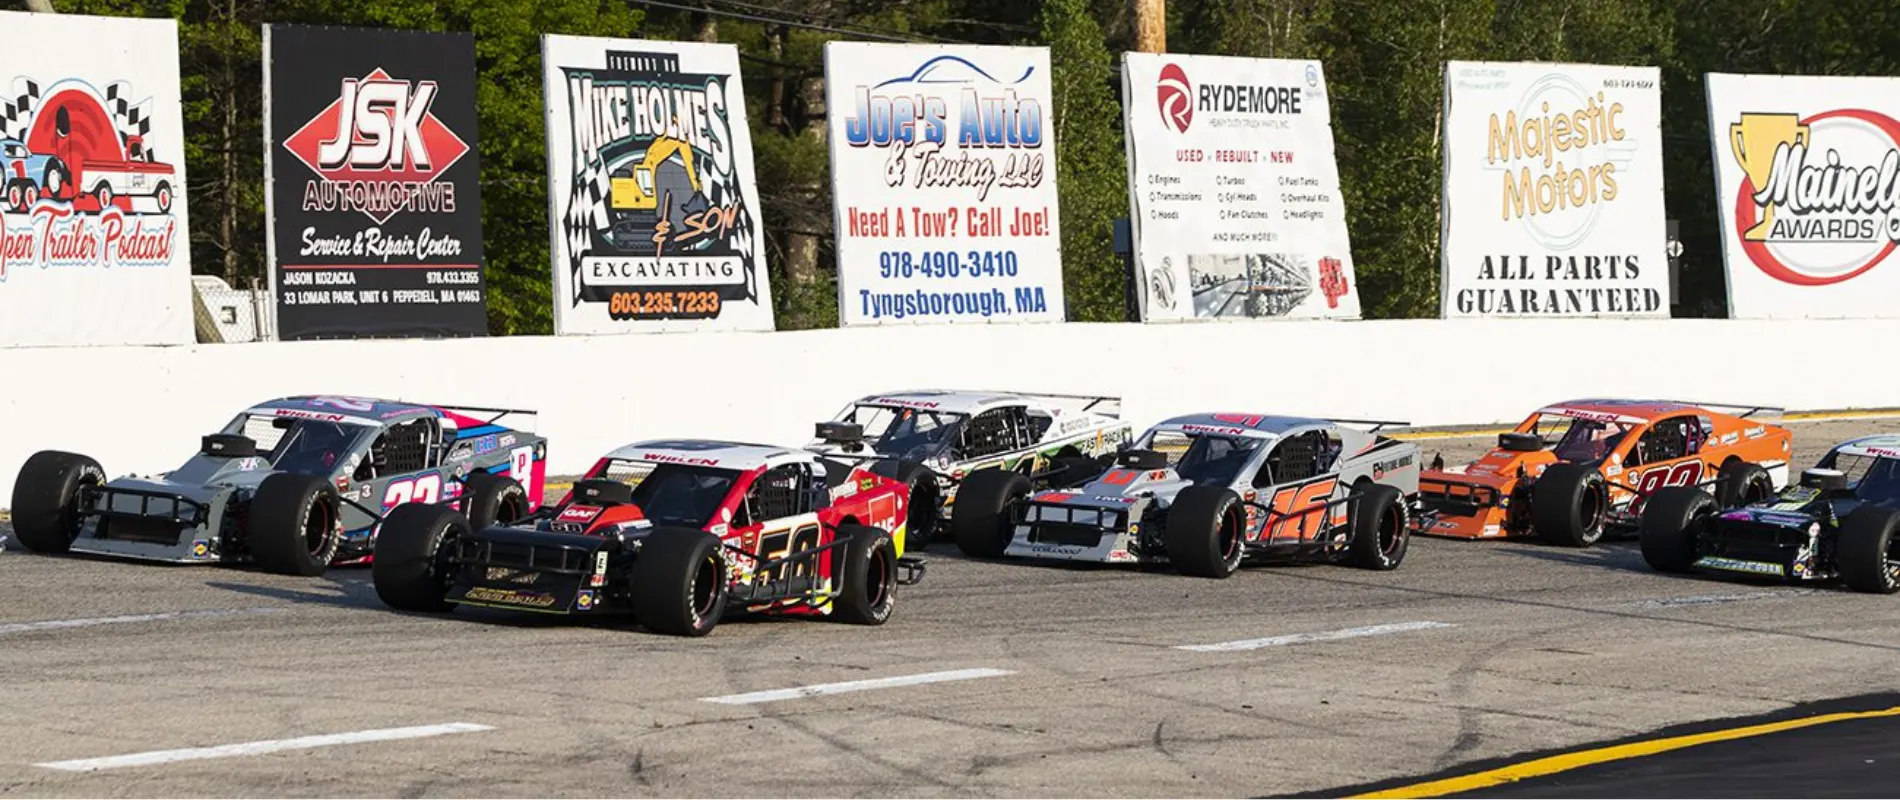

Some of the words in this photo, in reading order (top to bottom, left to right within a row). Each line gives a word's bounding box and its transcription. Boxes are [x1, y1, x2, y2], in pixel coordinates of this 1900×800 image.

[1198, 84, 1302, 114] RYDEMORE
[318, 78, 438, 172] JSK
[570, 73, 630, 182] MIKE
[630, 75, 732, 178] HOLMES
[845, 85, 947, 149] Joe's
[958, 88, 1043, 149] Auto
[1488, 91, 1625, 168] Majestic
[1176, 149, 1204, 162] USED
[1215, 149, 1259, 163] REBUILT
[1270, 150, 1294, 163] NEW
[884, 138, 906, 188] &
[912, 140, 995, 202] Towing
[998, 153, 1044, 188] LLC
[1155, 174, 1181, 187] Engines
[1223, 175, 1246, 186] Turbos
[302, 180, 456, 213] AUTOMOTIVE
[1157, 191, 1202, 202] Transmissions
[1503, 161, 1618, 221] Motors
[652, 189, 671, 262] &
[674, 202, 740, 242] SON
[848, 207, 889, 238] Need
[896, 208, 906, 238] A
[912, 207, 958, 238] Tow?
[967, 207, 1002, 237] Call
[1010, 207, 1050, 238] Joe!
[1158, 210, 1179, 220] Hoods
[1227, 209, 1240, 219] Fan
[1241, 209, 1268, 220] Clutches
[33, 205, 97, 263] Trailer
[101, 211, 174, 262] Podcast
[300, 226, 352, 256] Service
[353, 231, 363, 256] &
[365, 227, 415, 263] Repair
[416, 226, 462, 260] Center
[1213, 233, 1229, 242] AND
[1230, 233, 1250, 242] MUCH
[592, 261, 734, 278] EXCAVATING
[879, 251, 1018, 279] 978-490-3410
[1477, 255, 1534, 281] ALL
[1545, 255, 1641, 281] PARTS
[283, 271, 314, 285] JASON
[284, 292, 297, 305] 33
[298, 291, 331, 304] LOMAR
[332, 291, 358, 306] PARK,
[359, 290, 380, 304] UNIT
[381, 290, 389, 303] 6
[441, 289, 456, 303] MA
[457, 289, 481, 303] 01463
[611, 291, 719, 313] 603.235.7233
[860, 288, 1012, 319] Tyngsborough,
[1015, 287, 1047, 312] MA
[1457, 288, 1661, 314] GUARANTEED
[275, 408, 345, 422] WHELEN
[1564, 408, 1621, 422] WHELEN
[1182, 423, 1245, 436] WHELEN
[644, 452, 721, 467] WHELEN
[361, 484, 371, 498] 3
[564, 509, 595, 519] GAF
